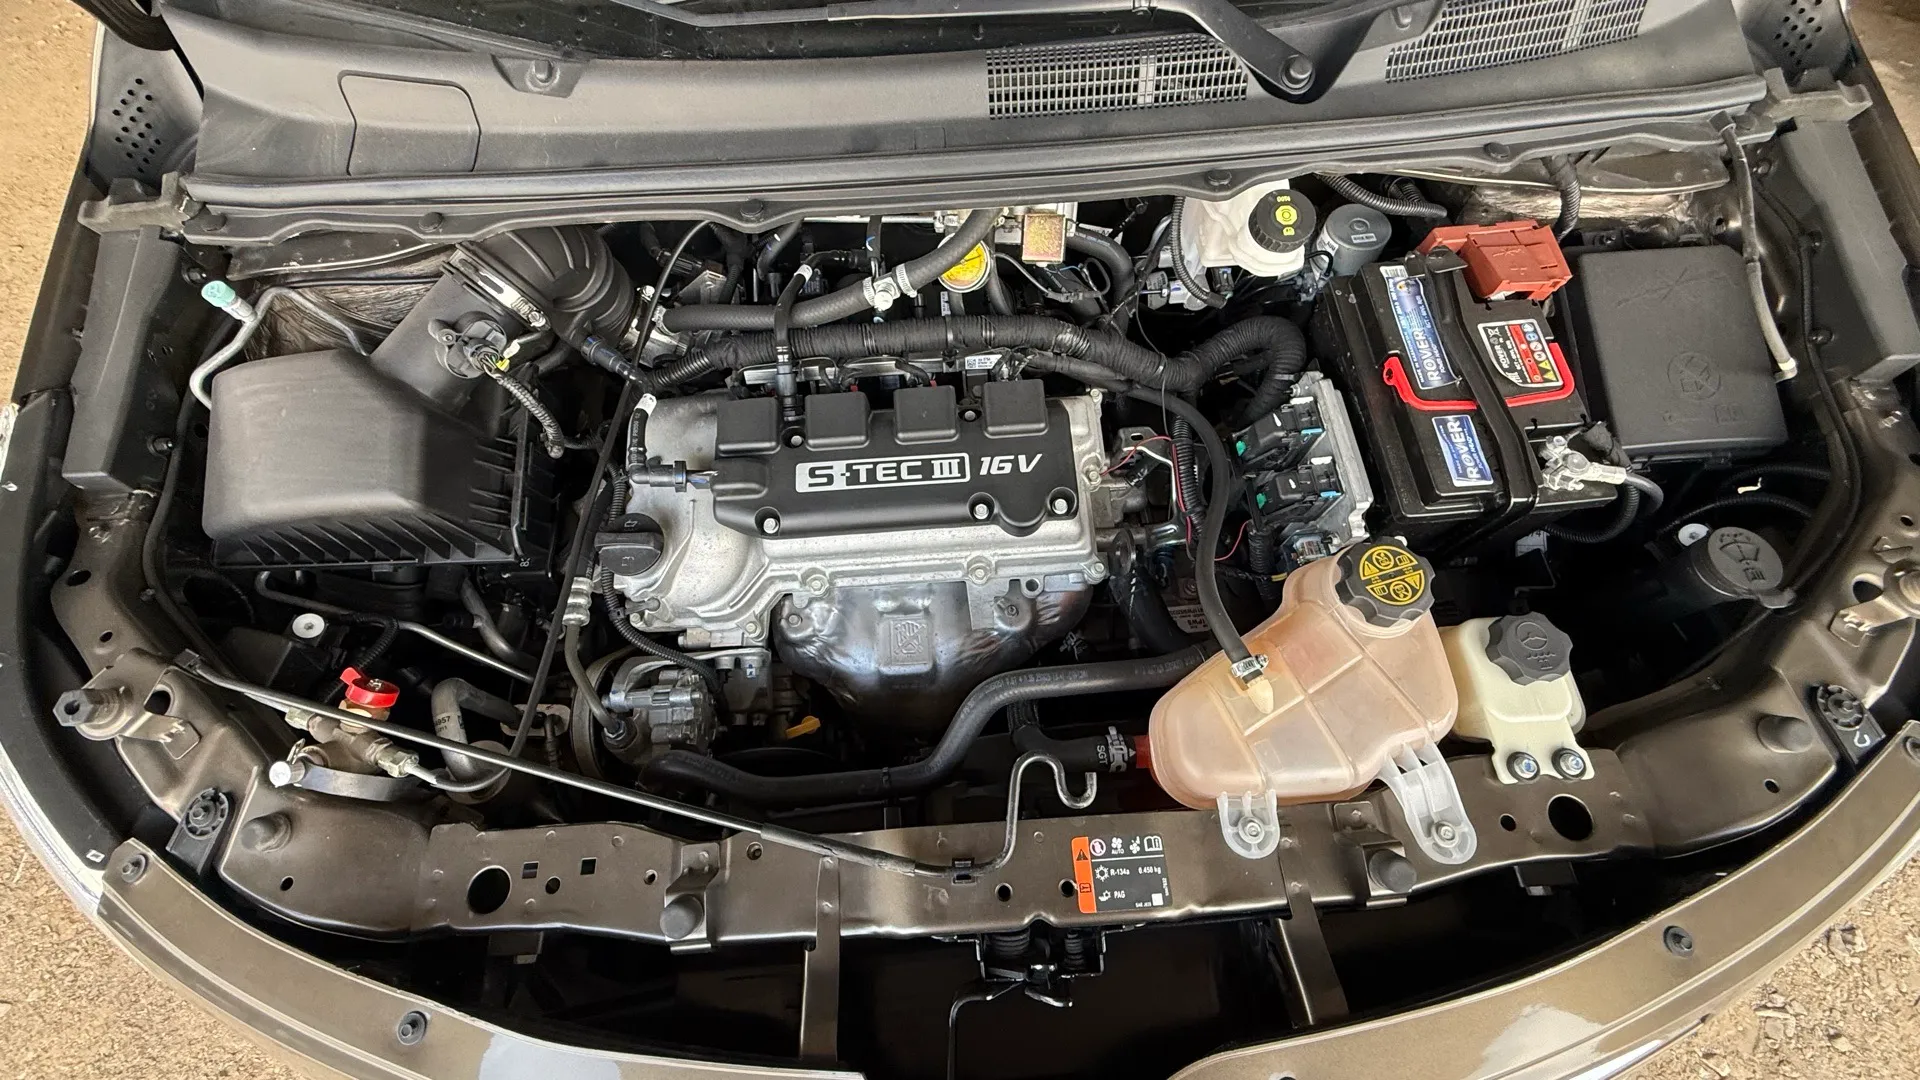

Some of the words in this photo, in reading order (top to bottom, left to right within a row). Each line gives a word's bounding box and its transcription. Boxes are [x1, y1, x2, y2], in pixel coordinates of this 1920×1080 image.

[1414, 330, 1441, 381] ROVER
[1494, 344, 1509, 369] ROVER
[1447, 420, 1481, 478] ROVER
[808, 461, 922, 488] S-TEC
[931, 459, 961, 479] III
[979, 453, 1043, 476] 16V
[1097, 745, 1108, 765] SGT
[1110, 867, 1130, 876] R-134a
[1113, 890, 1126, 899] PAG
